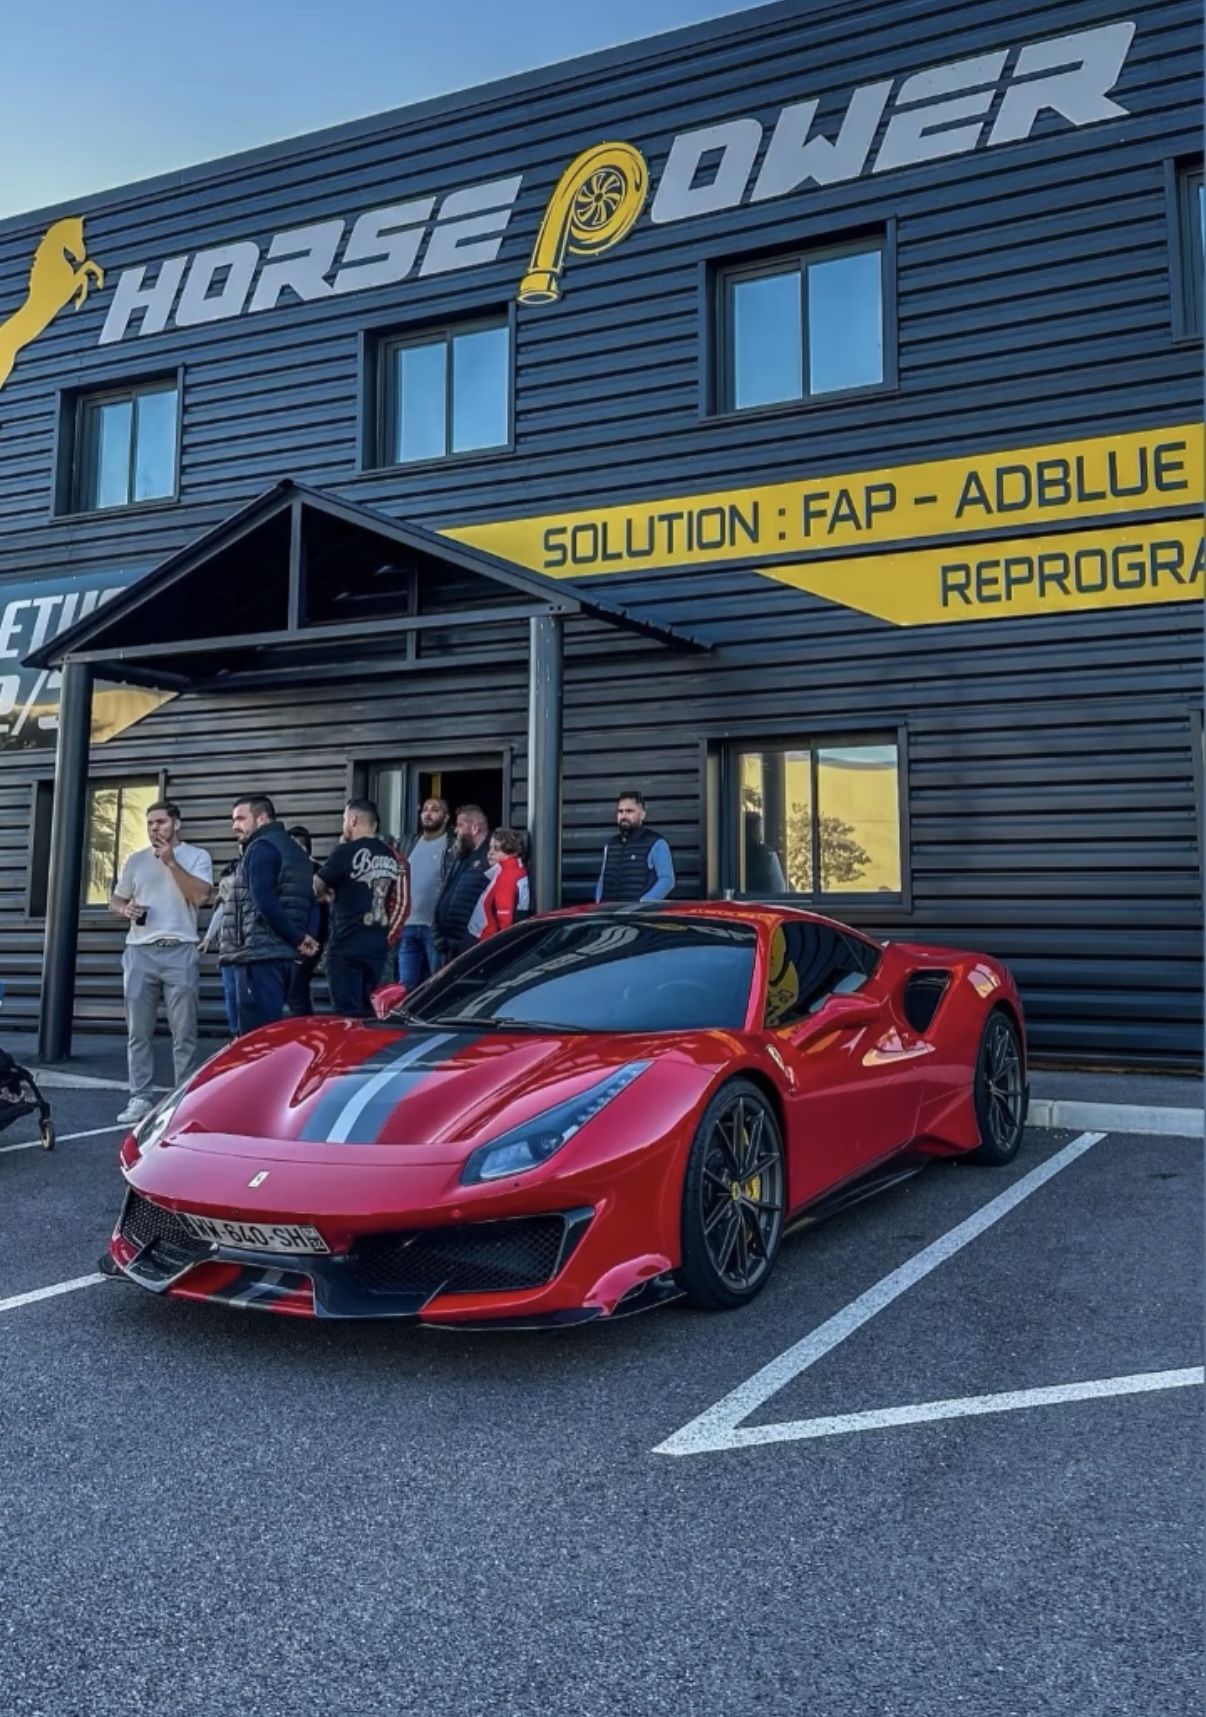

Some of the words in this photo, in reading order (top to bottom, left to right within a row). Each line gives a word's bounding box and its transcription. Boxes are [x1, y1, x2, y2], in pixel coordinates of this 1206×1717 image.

[98, 174, 524, 345] HORSE
[543, 500, 760, 568] SOLUTION
[802, 482, 898, 537] FAP
[955, 440, 1189, 519] ADBLUE
